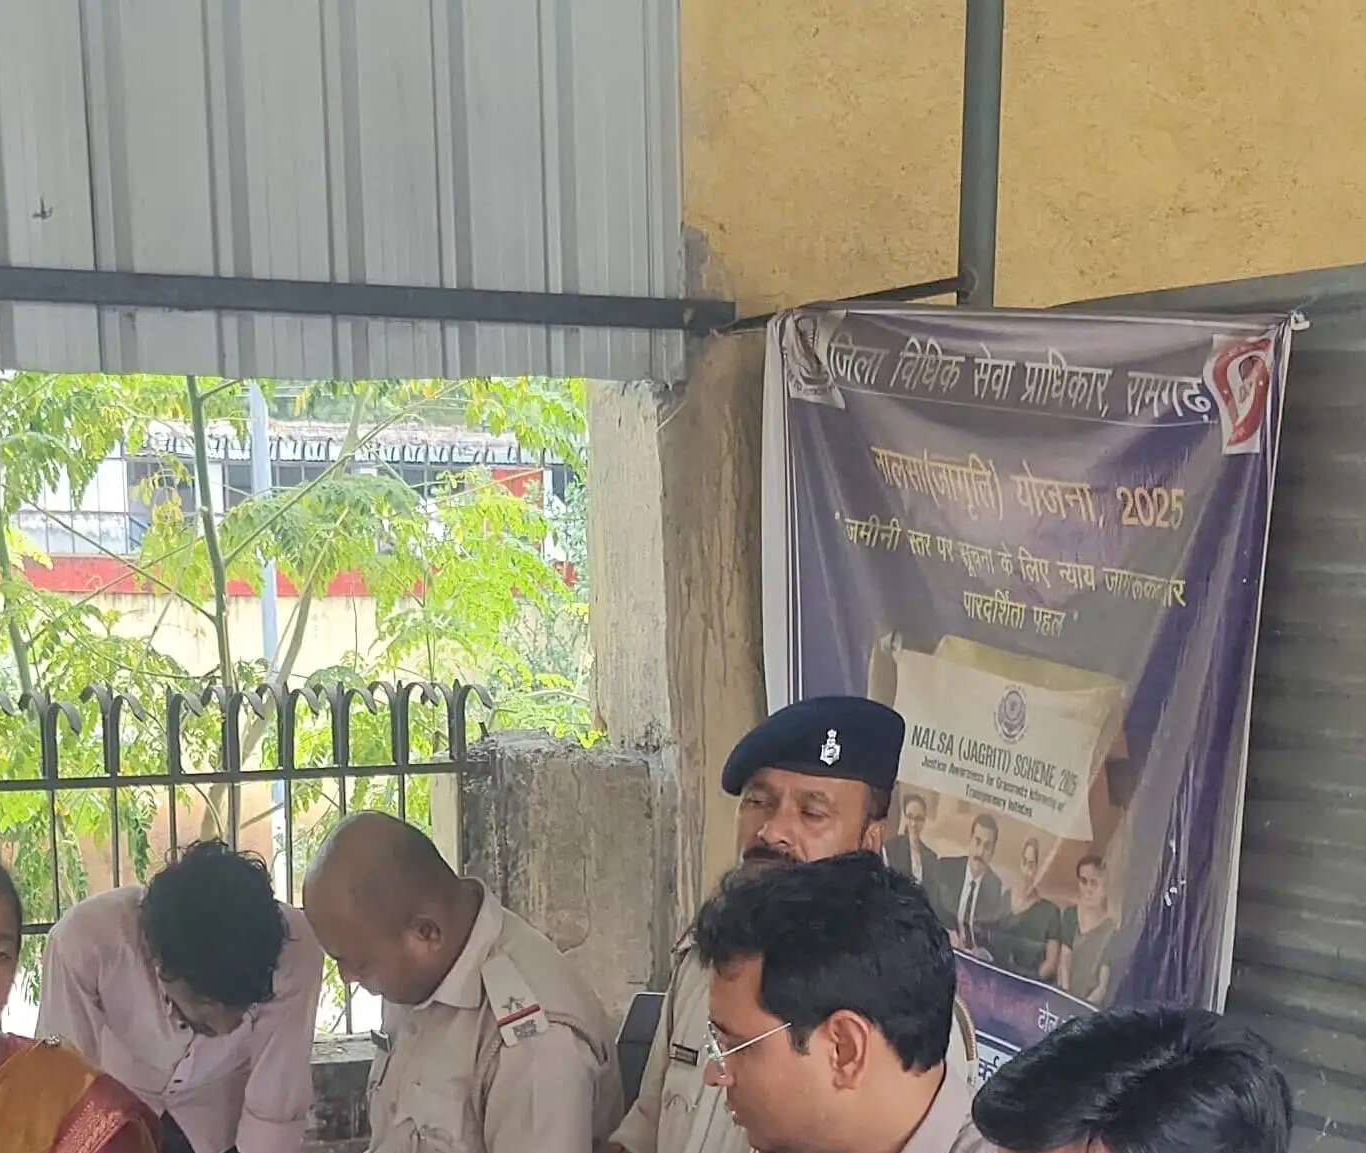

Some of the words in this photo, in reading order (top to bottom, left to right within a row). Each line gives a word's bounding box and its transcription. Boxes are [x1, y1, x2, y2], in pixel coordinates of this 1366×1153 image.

[890, 336, 966, 393] विधिक
[973, 342, 1016, 400] सेवा
[1127, 371, 1212, 424] रामगढ़
[1116, 486, 1185, 529] 2025
[907, 529, 932, 557] स्तर
[936, 536, 955, 563] पर
[997, 541, 1014, 577] के
[1017, 545, 1051, 588] लिए
[1056, 561, 1096, 591] न्याय
[963, 588, 1026, 630] पारदर्शिता
[1032, 605, 1067, 638] पहल
[911, 724, 955, 757] NALSA
